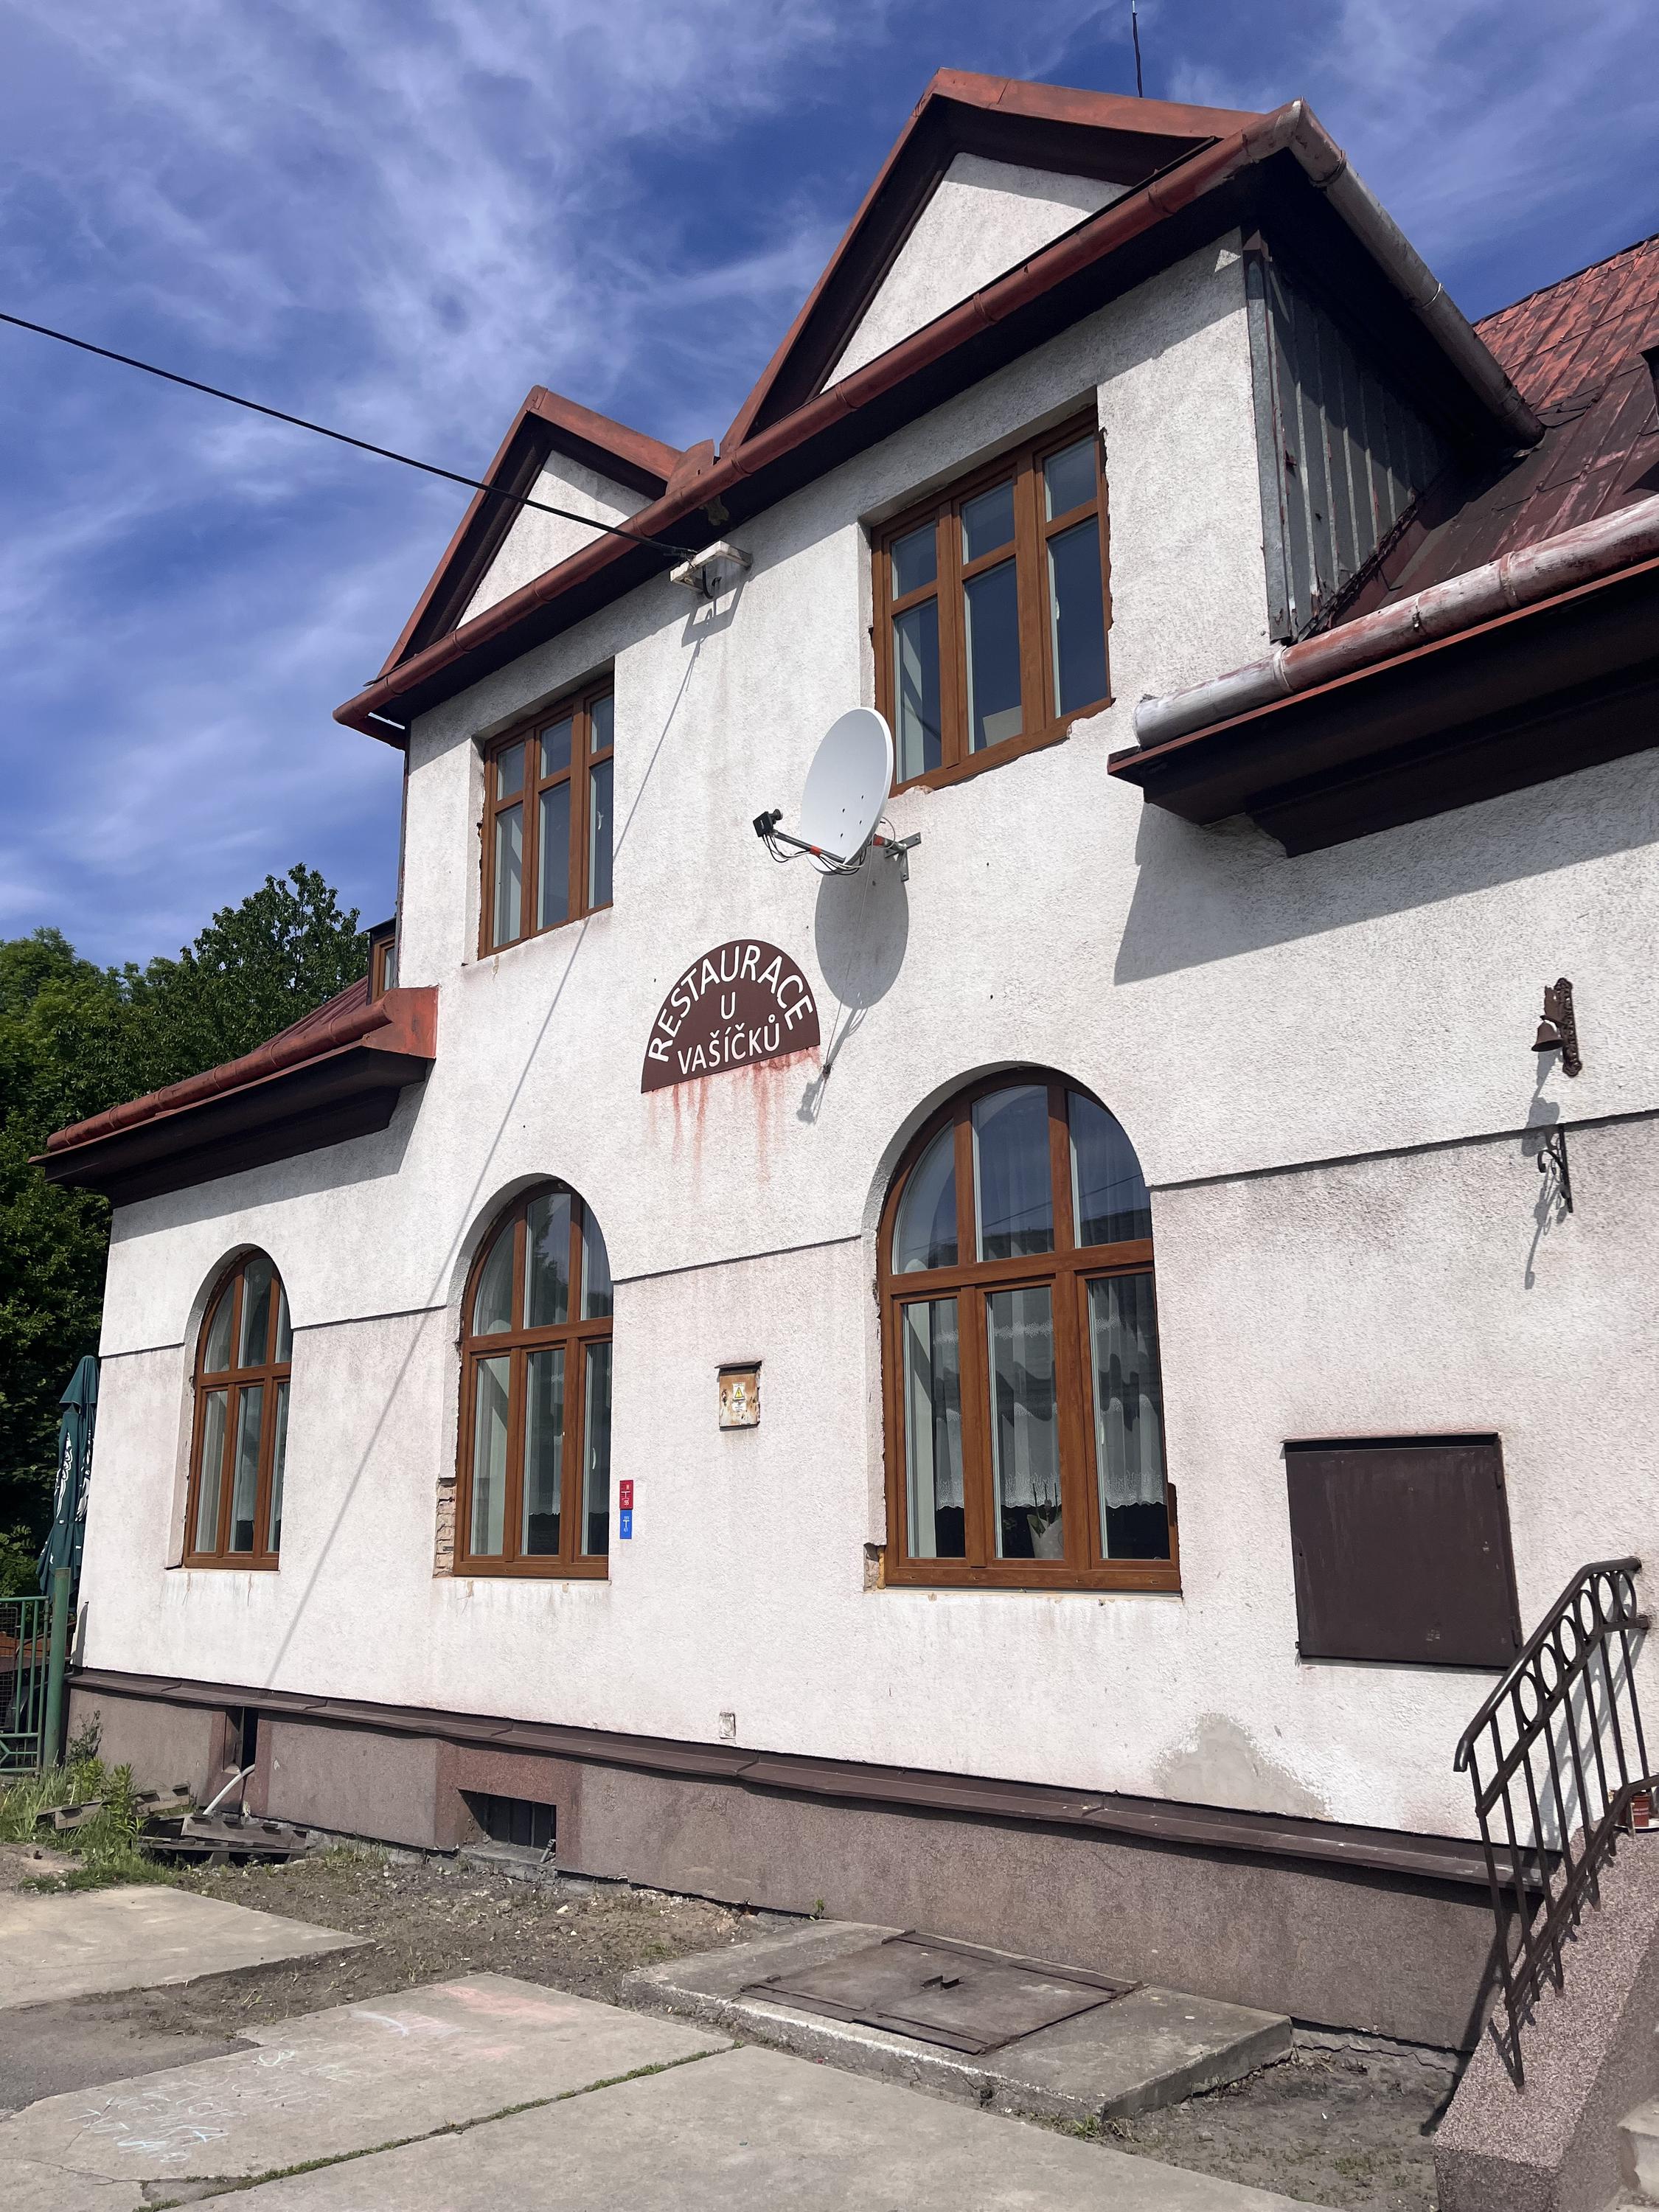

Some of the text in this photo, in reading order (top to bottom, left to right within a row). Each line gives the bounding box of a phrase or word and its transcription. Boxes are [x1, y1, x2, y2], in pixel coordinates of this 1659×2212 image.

[648, 945, 814, 1062] RESTAURACE
[720, 991, 736, 1020] U
[677, 1014, 780, 1075] VAŠÍČKŮ
